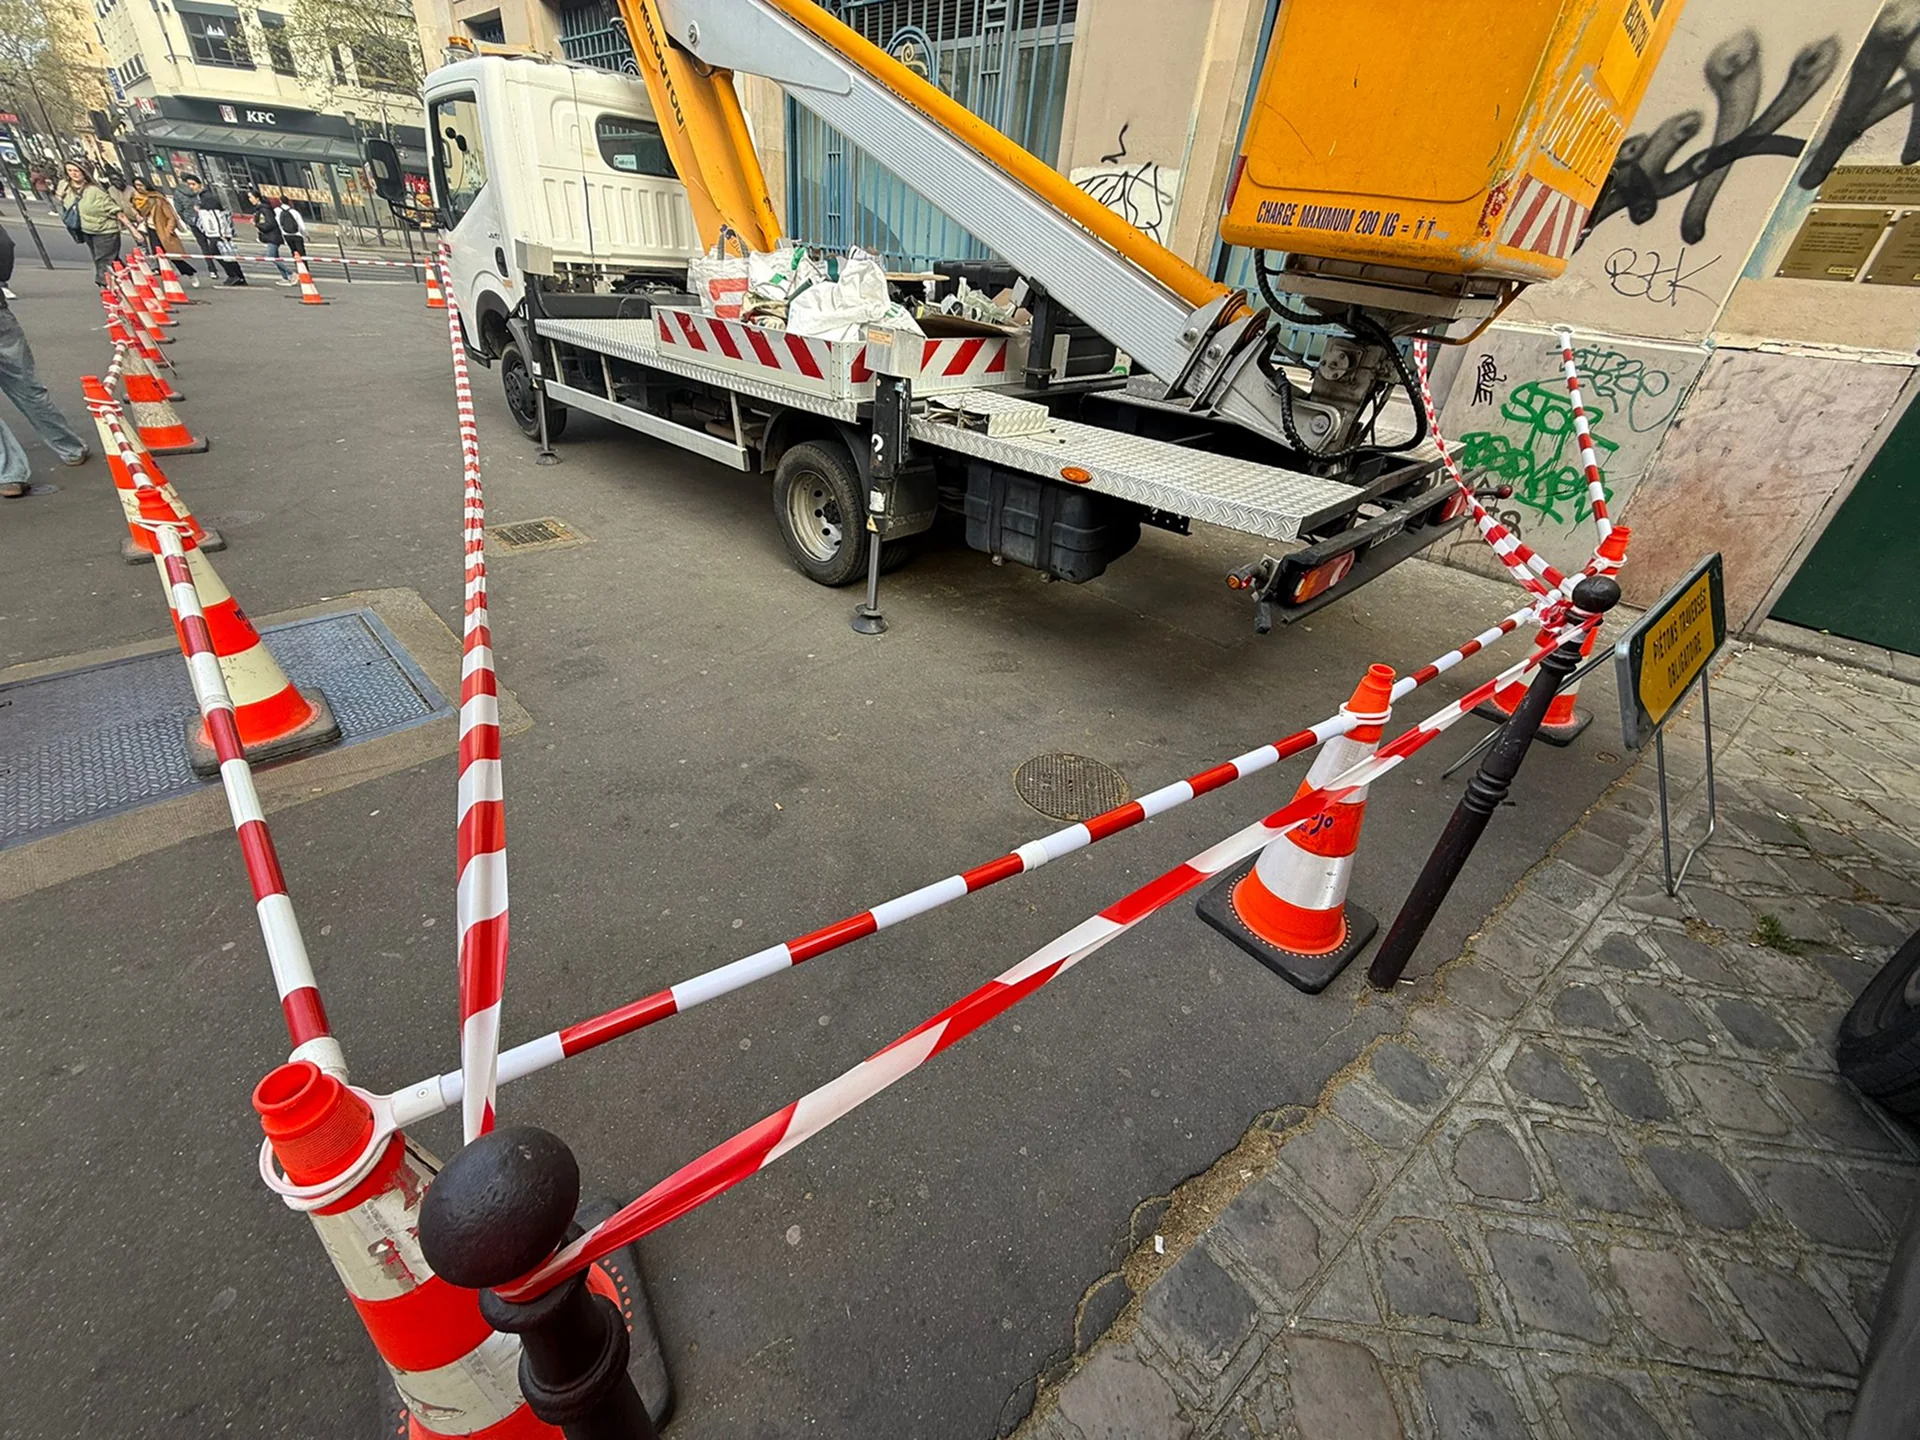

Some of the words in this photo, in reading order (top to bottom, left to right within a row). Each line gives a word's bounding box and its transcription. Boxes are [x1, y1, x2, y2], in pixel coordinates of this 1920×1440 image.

[246, 110, 276, 125] KFC
[1256, 200, 1298, 226] CHARGE
[1297, 204, 1355, 233] MAXIMUM
[1354, 209, 1380, 235] 200
[1379, 212, 1400, 237] KG
[1667, 630, 1702, 689] OBLIGATOIRE
